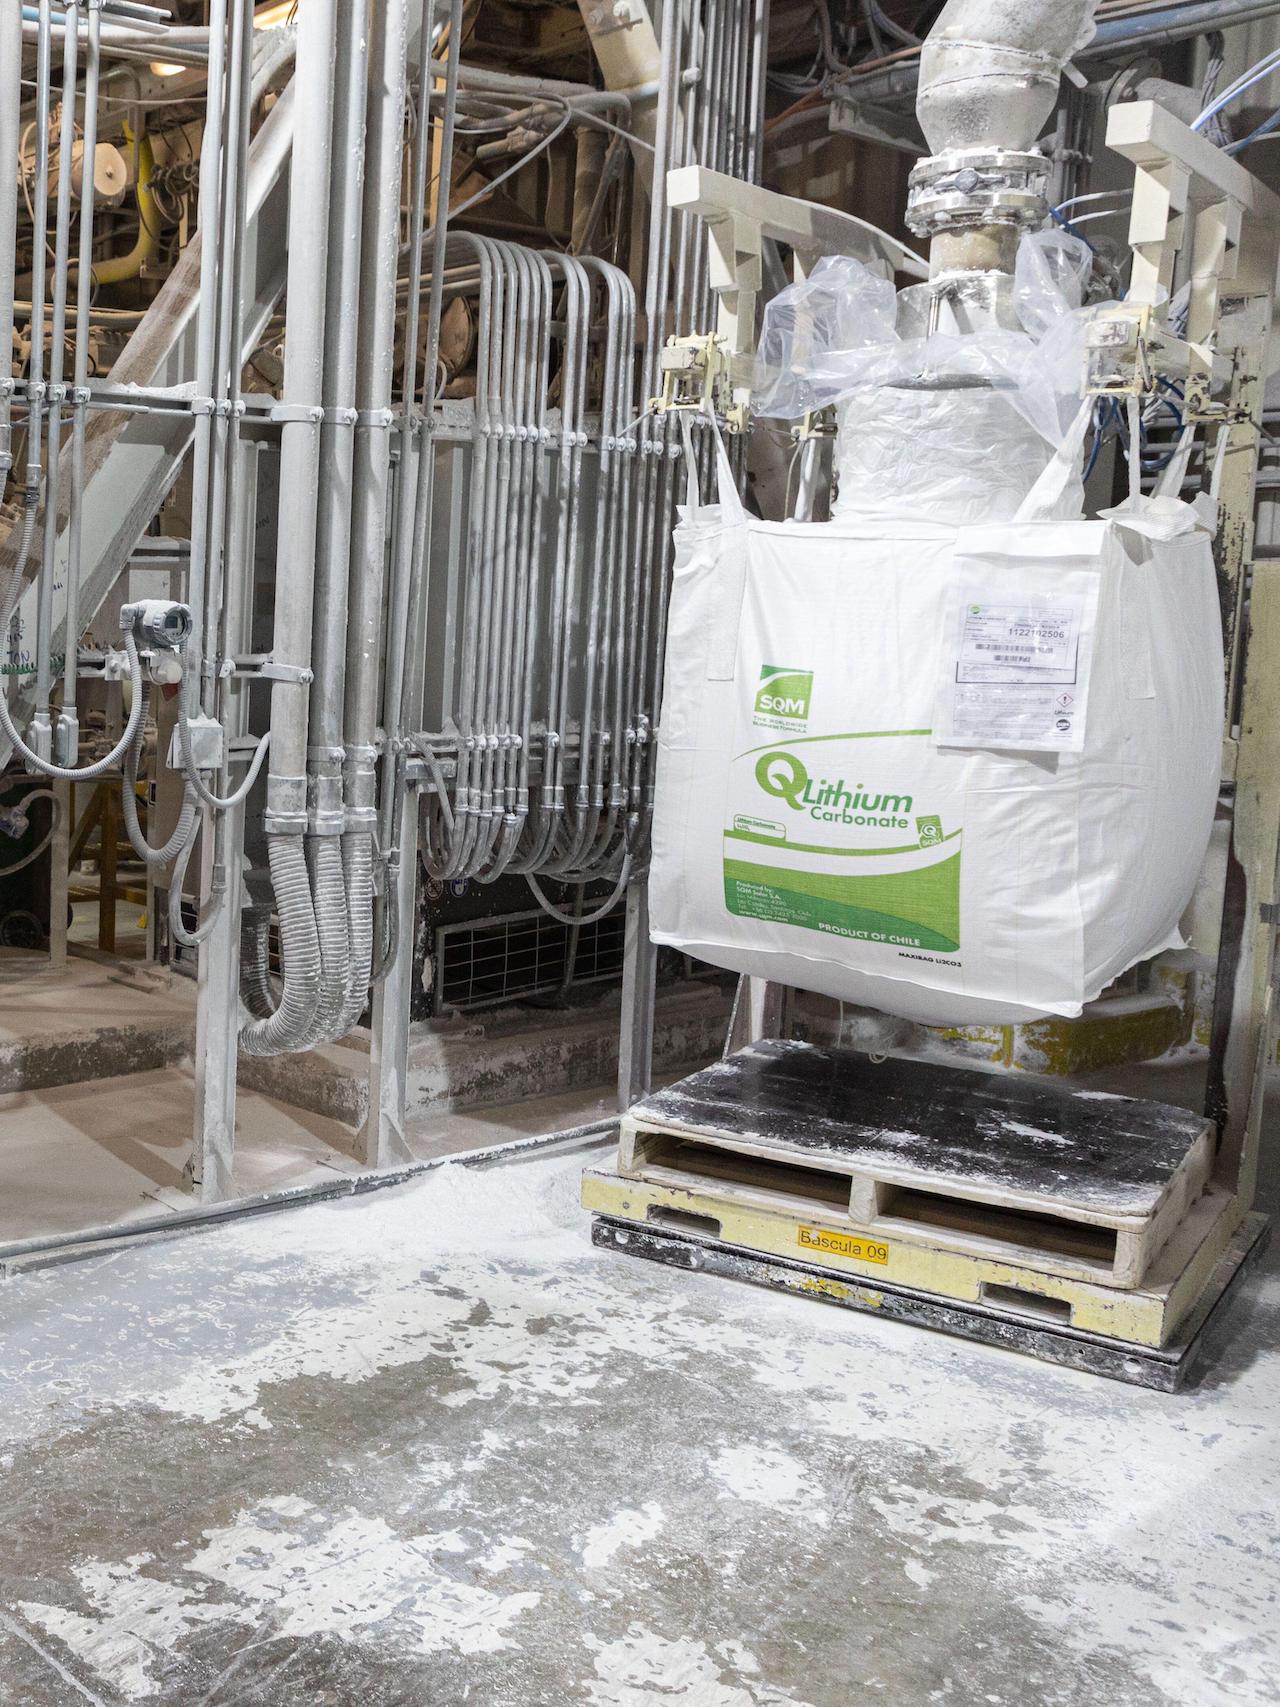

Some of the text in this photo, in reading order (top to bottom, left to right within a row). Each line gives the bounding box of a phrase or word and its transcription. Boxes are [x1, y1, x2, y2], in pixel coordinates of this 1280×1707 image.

[759, 694, 806, 715] SQM
[810, 806, 909, 829] Carbonate
[818, 922, 921, 947] PRODUCT OF CHILE
[898, 952, 934, 963] MAXIBAG
[800, 1230, 887, 1260] Bascula 09
